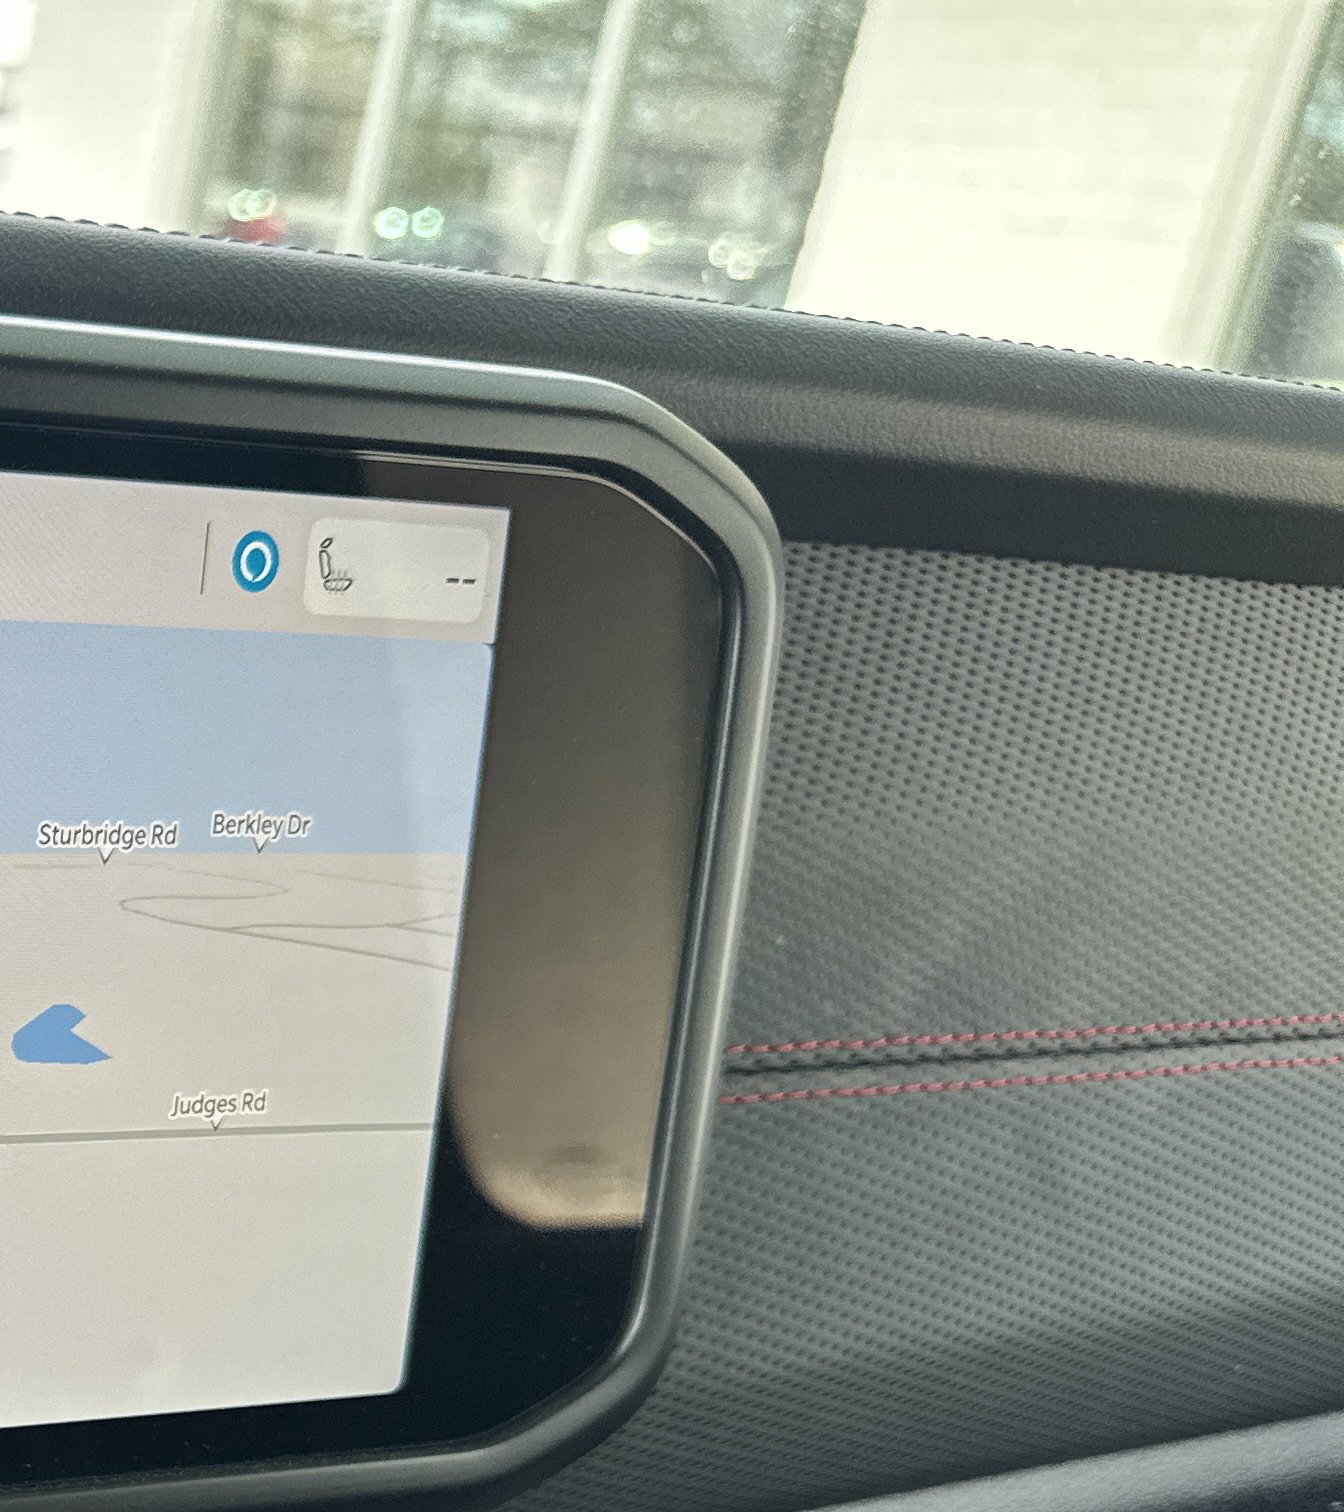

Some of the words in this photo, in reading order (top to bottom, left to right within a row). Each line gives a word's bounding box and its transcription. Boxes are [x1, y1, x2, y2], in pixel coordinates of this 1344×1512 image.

[38, 822, 146, 849] Sturbridge
[150, 824, 178, 847] Rd
[212, 812, 284, 839] Berkley
[287, 814, 311, 836] Dr
[171, 1094, 237, 1119] Judges
[241, 1092, 266, 1114] Rd
